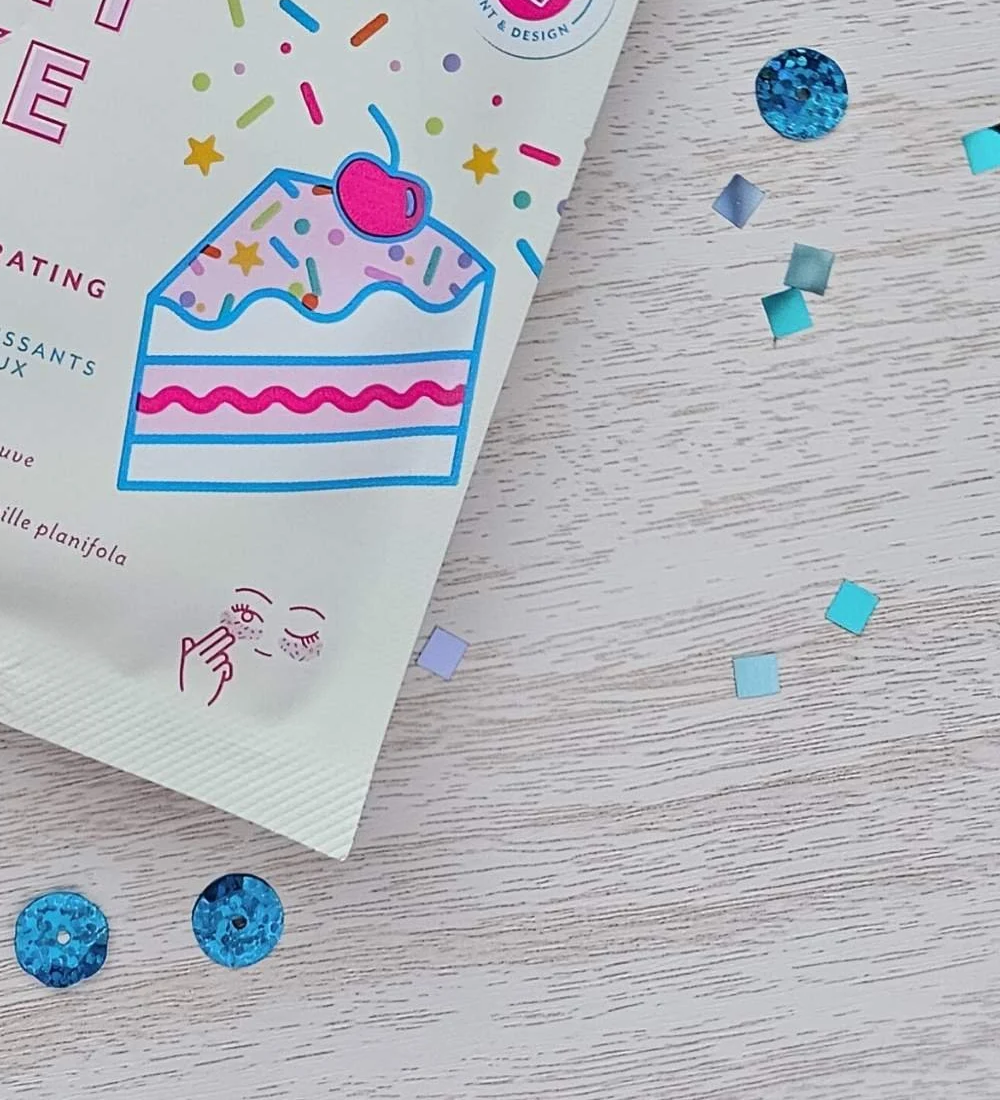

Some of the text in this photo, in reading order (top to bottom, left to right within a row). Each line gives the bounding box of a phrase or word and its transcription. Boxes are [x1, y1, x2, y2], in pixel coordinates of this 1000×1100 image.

[497, 20, 506, 32] &
[511, 23, 569, 42] DESIGN
[34, 523, 127, 566] planifola
